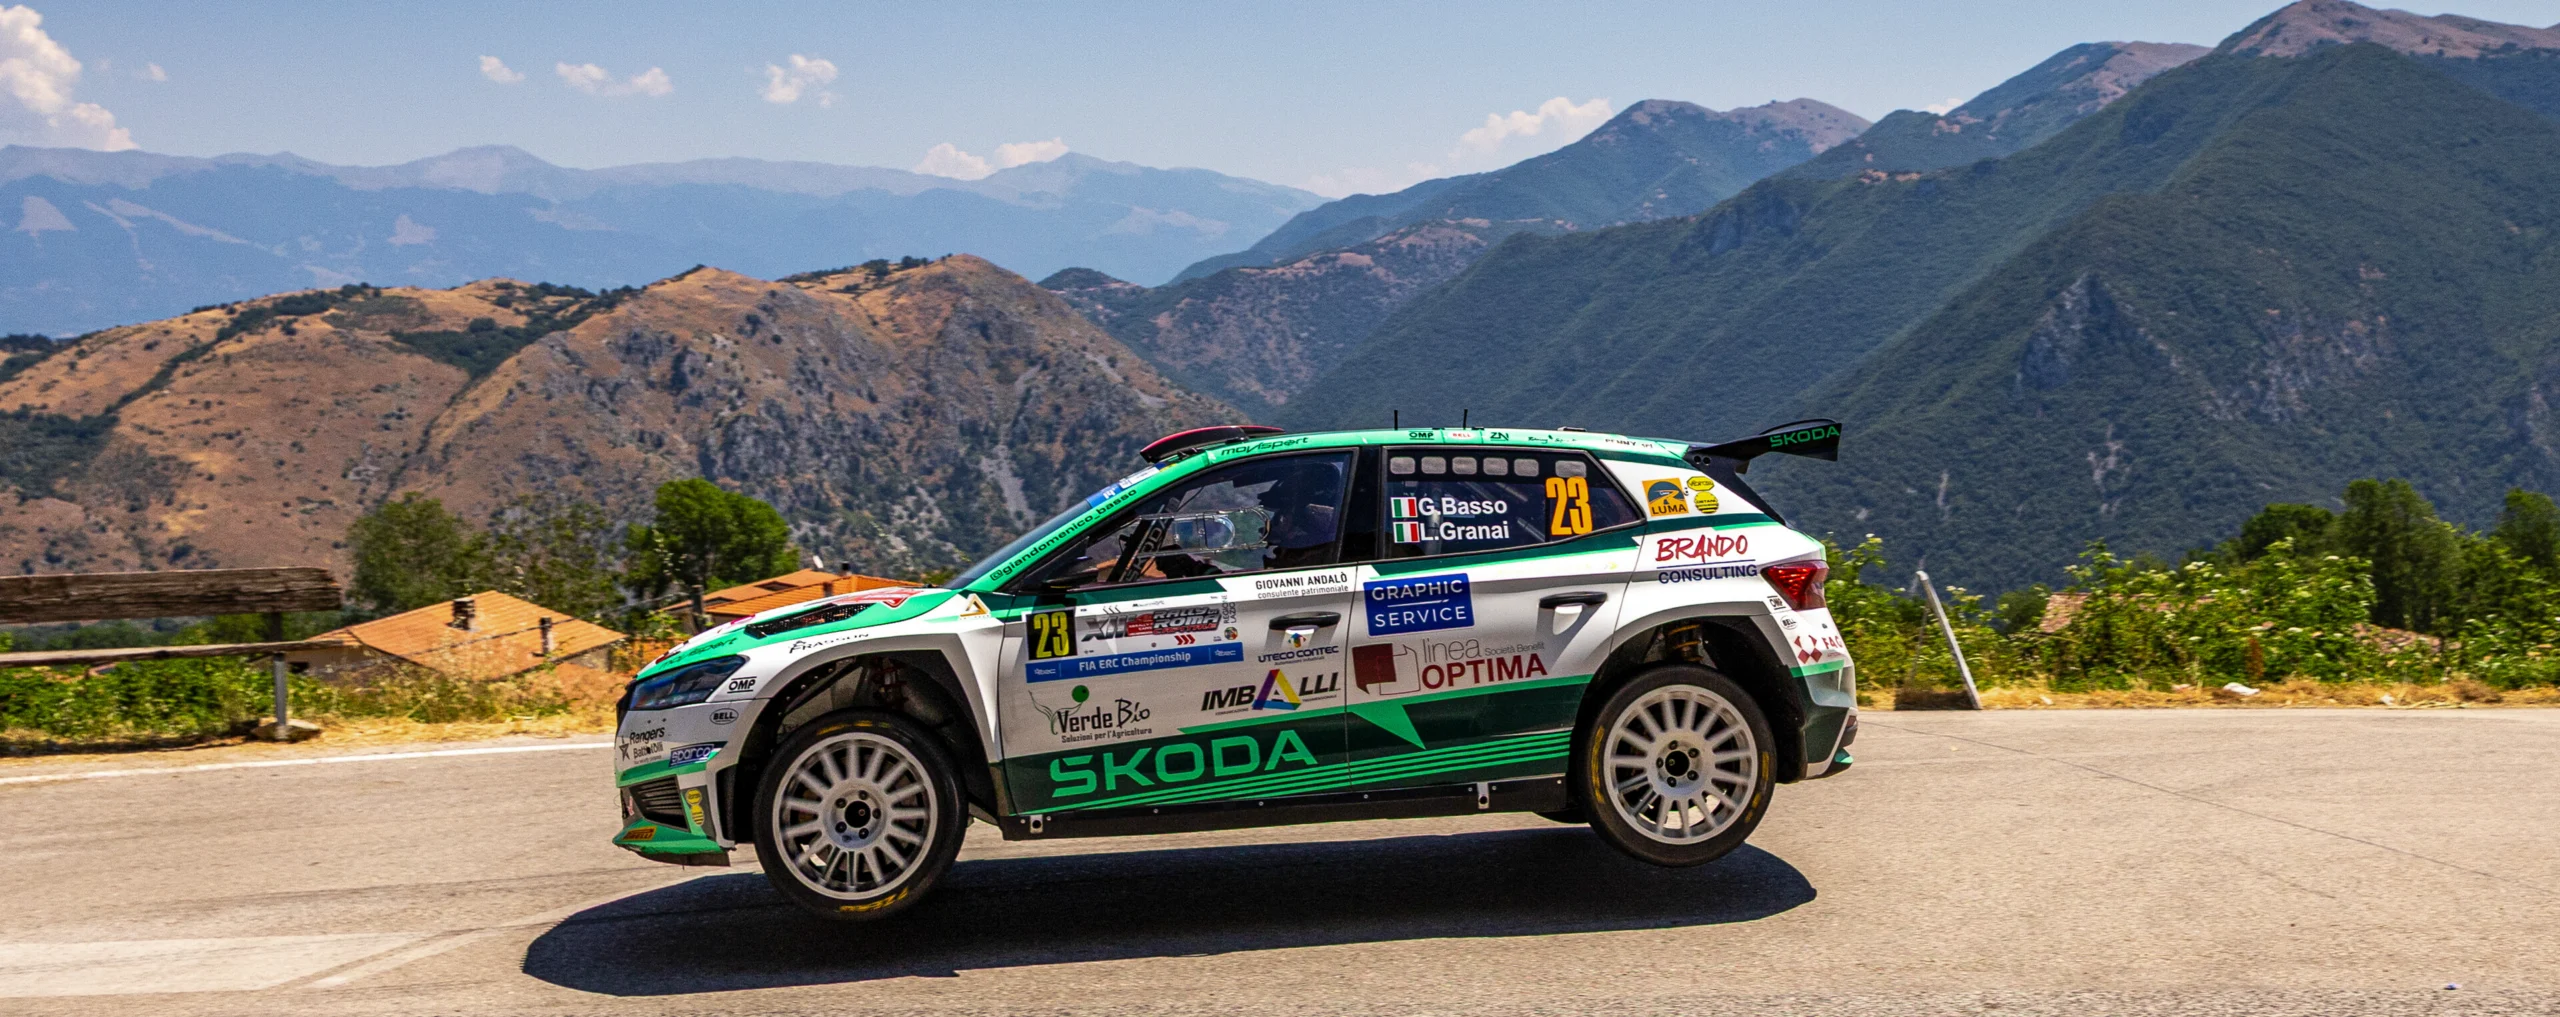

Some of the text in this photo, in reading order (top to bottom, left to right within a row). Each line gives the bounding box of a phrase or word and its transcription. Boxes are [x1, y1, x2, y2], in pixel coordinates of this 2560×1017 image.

[1418, 498, 1508, 516] G.Basso
[1545, 476, 1593, 536] 23
[1651, 504, 1687, 515] LUMA
[990, 489, 1137, 581] @giandomenico_basso
[1420, 521, 1510, 541] L.Granai
[1655, 534, 1748, 563] BRANDO
[1255, 571, 1348, 590] GIOVANNI ANDALÒ
[1658, 564, 1758, 584] CONSULTING
[1258, 584, 1349, 599] consulente patrimoniale
[1371, 580, 1463, 601] GRAPHIC
[1153, 607, 1209, 619] RALLY
[1153, 614, 1219, 628] ROMA
[1375, 606, 1467, 628] SERVICE
[1033, 611, 1070, 658] 23
[1258, 651, 1295, 663] UTECO
[1422, 638, 1482, 663] linea
[1484, 646, 1515, 657] Società
[1079, 651, 1191, 671] FIA ERC Championship
[1422, 653, 1548, 689] OPTIMA
[728, 679, 756, 691] OMP
[713, 711, 735, 721] BELL
[1057, 698, 1151, 733] Verde Bio
[629, 726, 665, 745] Rangers
[1094, 731, 1106, 742] per
[671, 747, 711, 763] sparco
